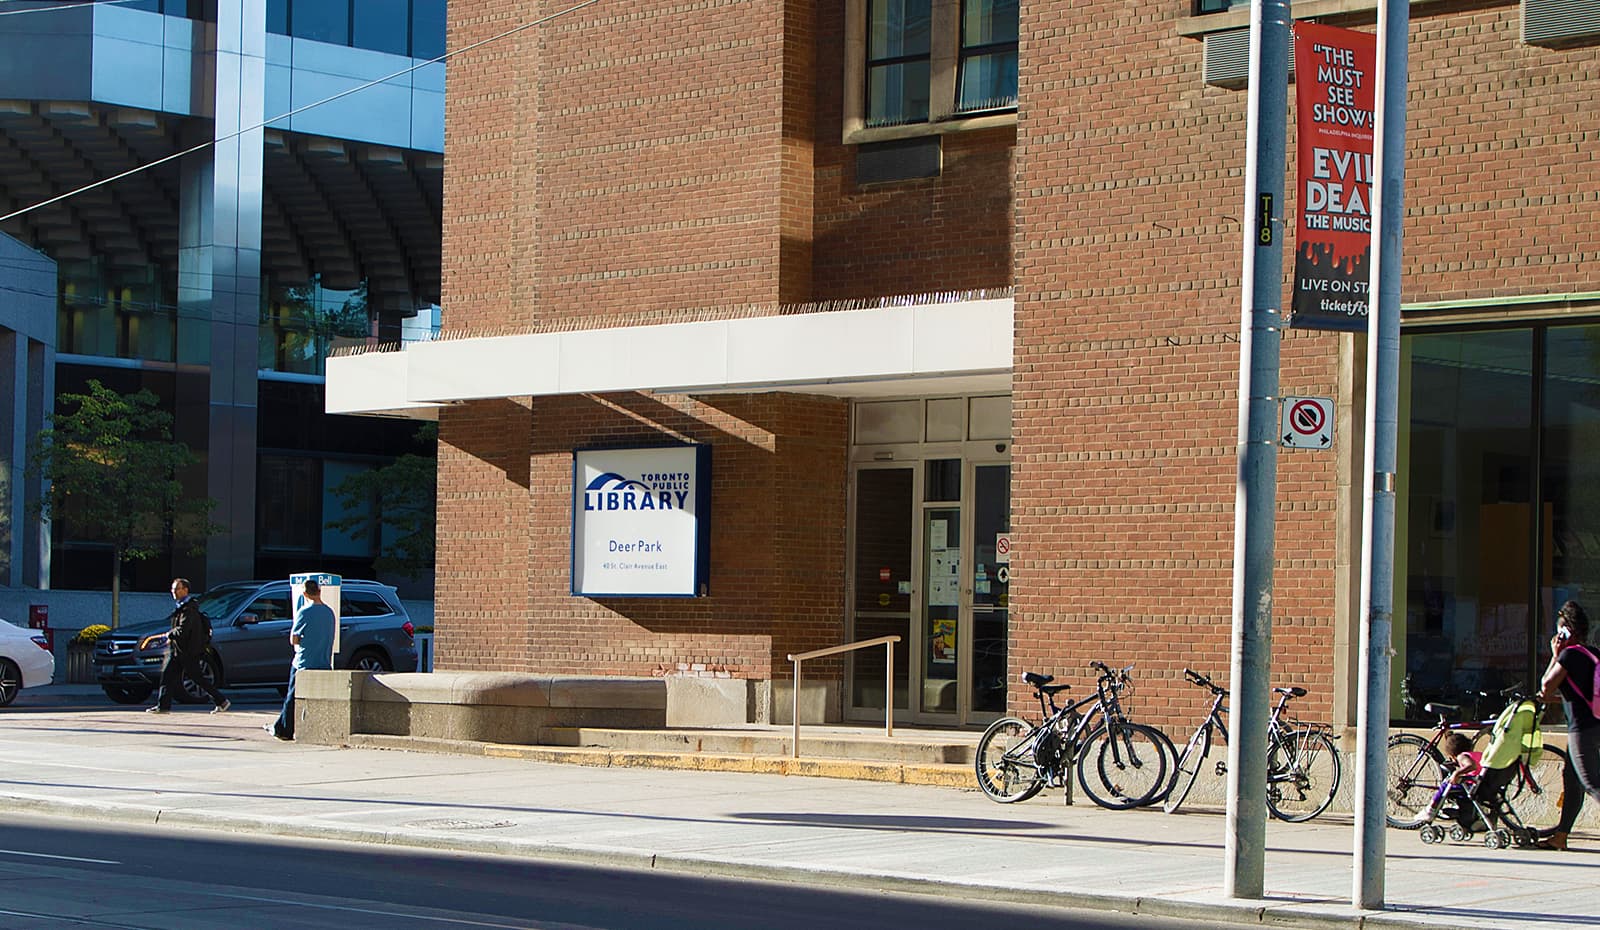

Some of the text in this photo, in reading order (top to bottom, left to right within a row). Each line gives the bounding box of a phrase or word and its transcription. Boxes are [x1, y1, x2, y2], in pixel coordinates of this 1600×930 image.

[1318, 65, 1363, 88] MUST
[1328, 86, 1354, 106] SEE
[1318, 128, 1350, 137] PHILADELPHIA
[1260, 196, 1272, 243] T18
[1305, 214, 1330, 229] THE
[1301, 278, 1371, 294] LIVE ON ST
[641, 473, 690, 481] TORONTO
[652, 482, 689, 490] PUBLIC
[585, 491, 689, 511] LIBRARY
[609, 540, 662, 552] Deer Park
[619, 562, 633, 570] Clair
[318, 575, 332, 585] Bell
